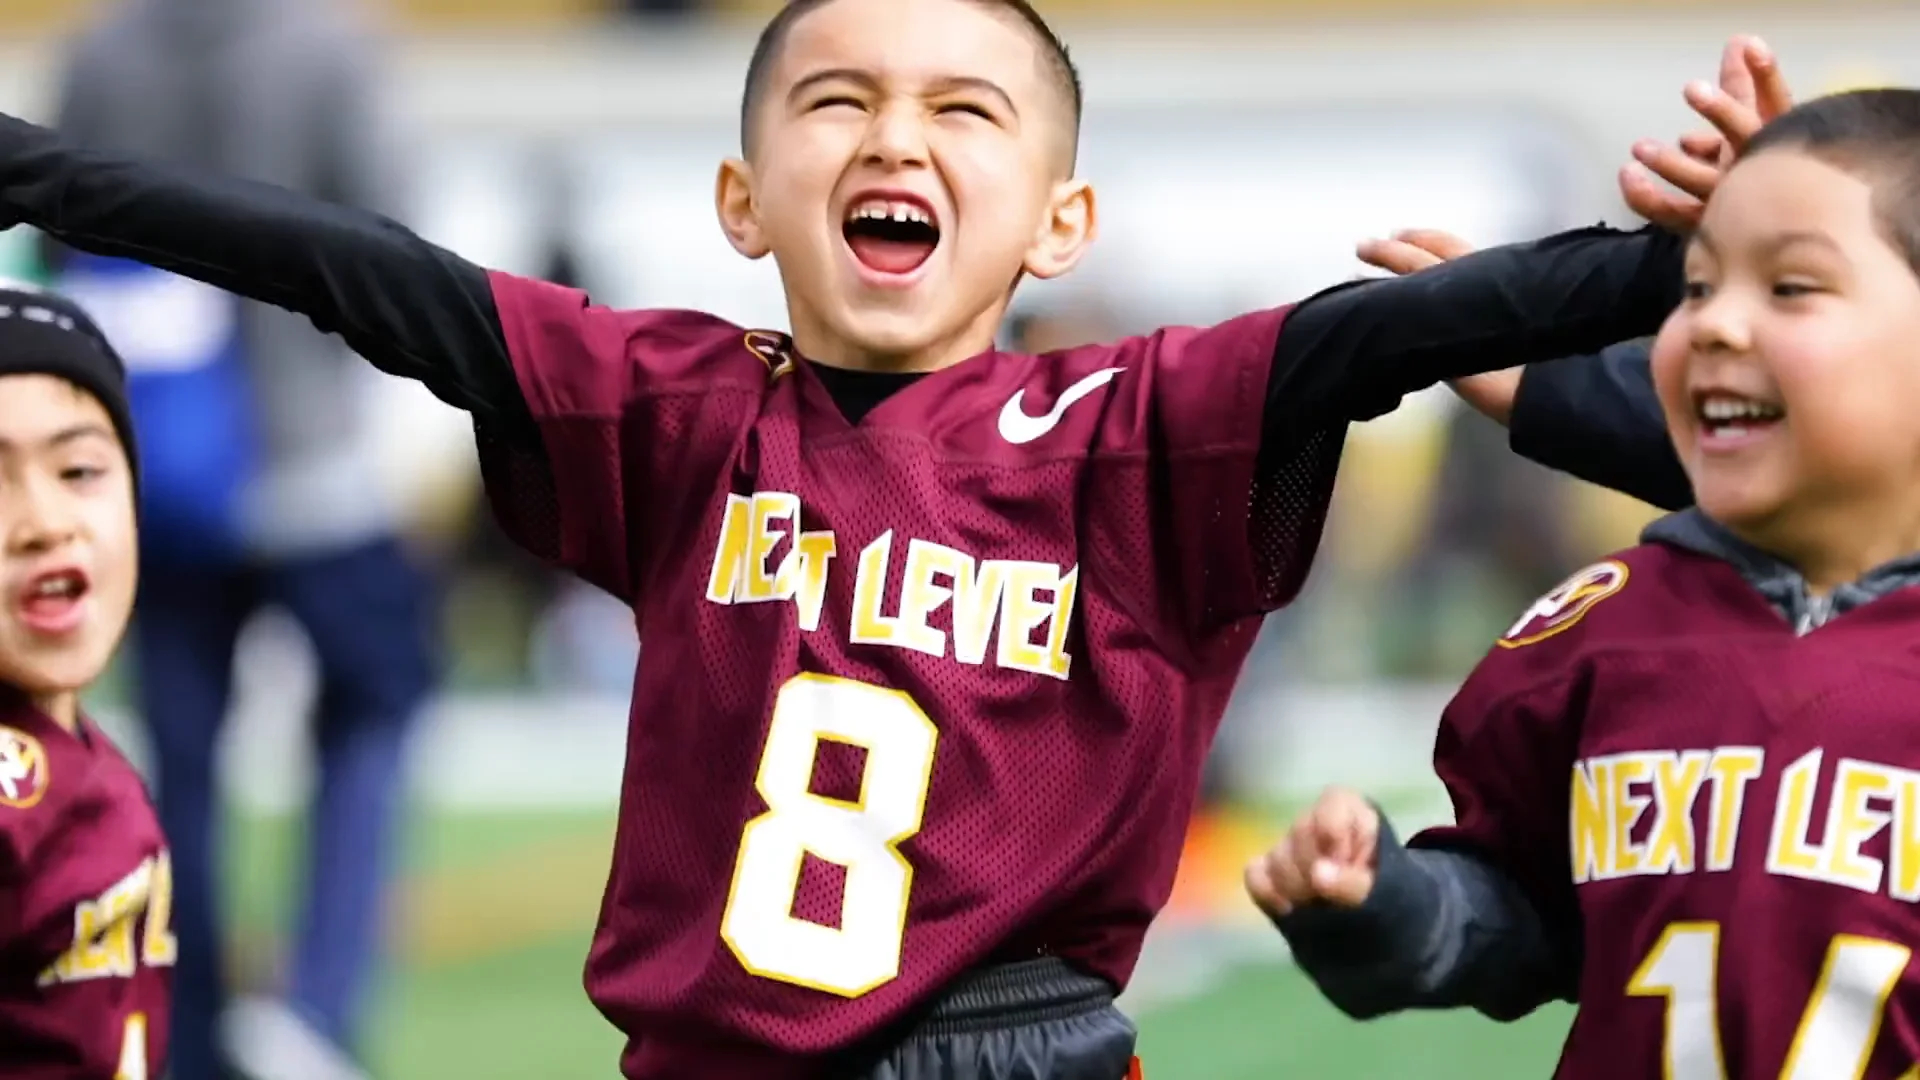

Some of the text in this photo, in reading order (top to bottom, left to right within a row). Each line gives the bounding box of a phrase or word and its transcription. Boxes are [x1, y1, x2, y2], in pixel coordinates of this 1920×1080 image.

[849, 528, 1079, 680] LEVEL
[720, 671, 940, 999] 8
[1570, 745, 1765, 884] NEXT
